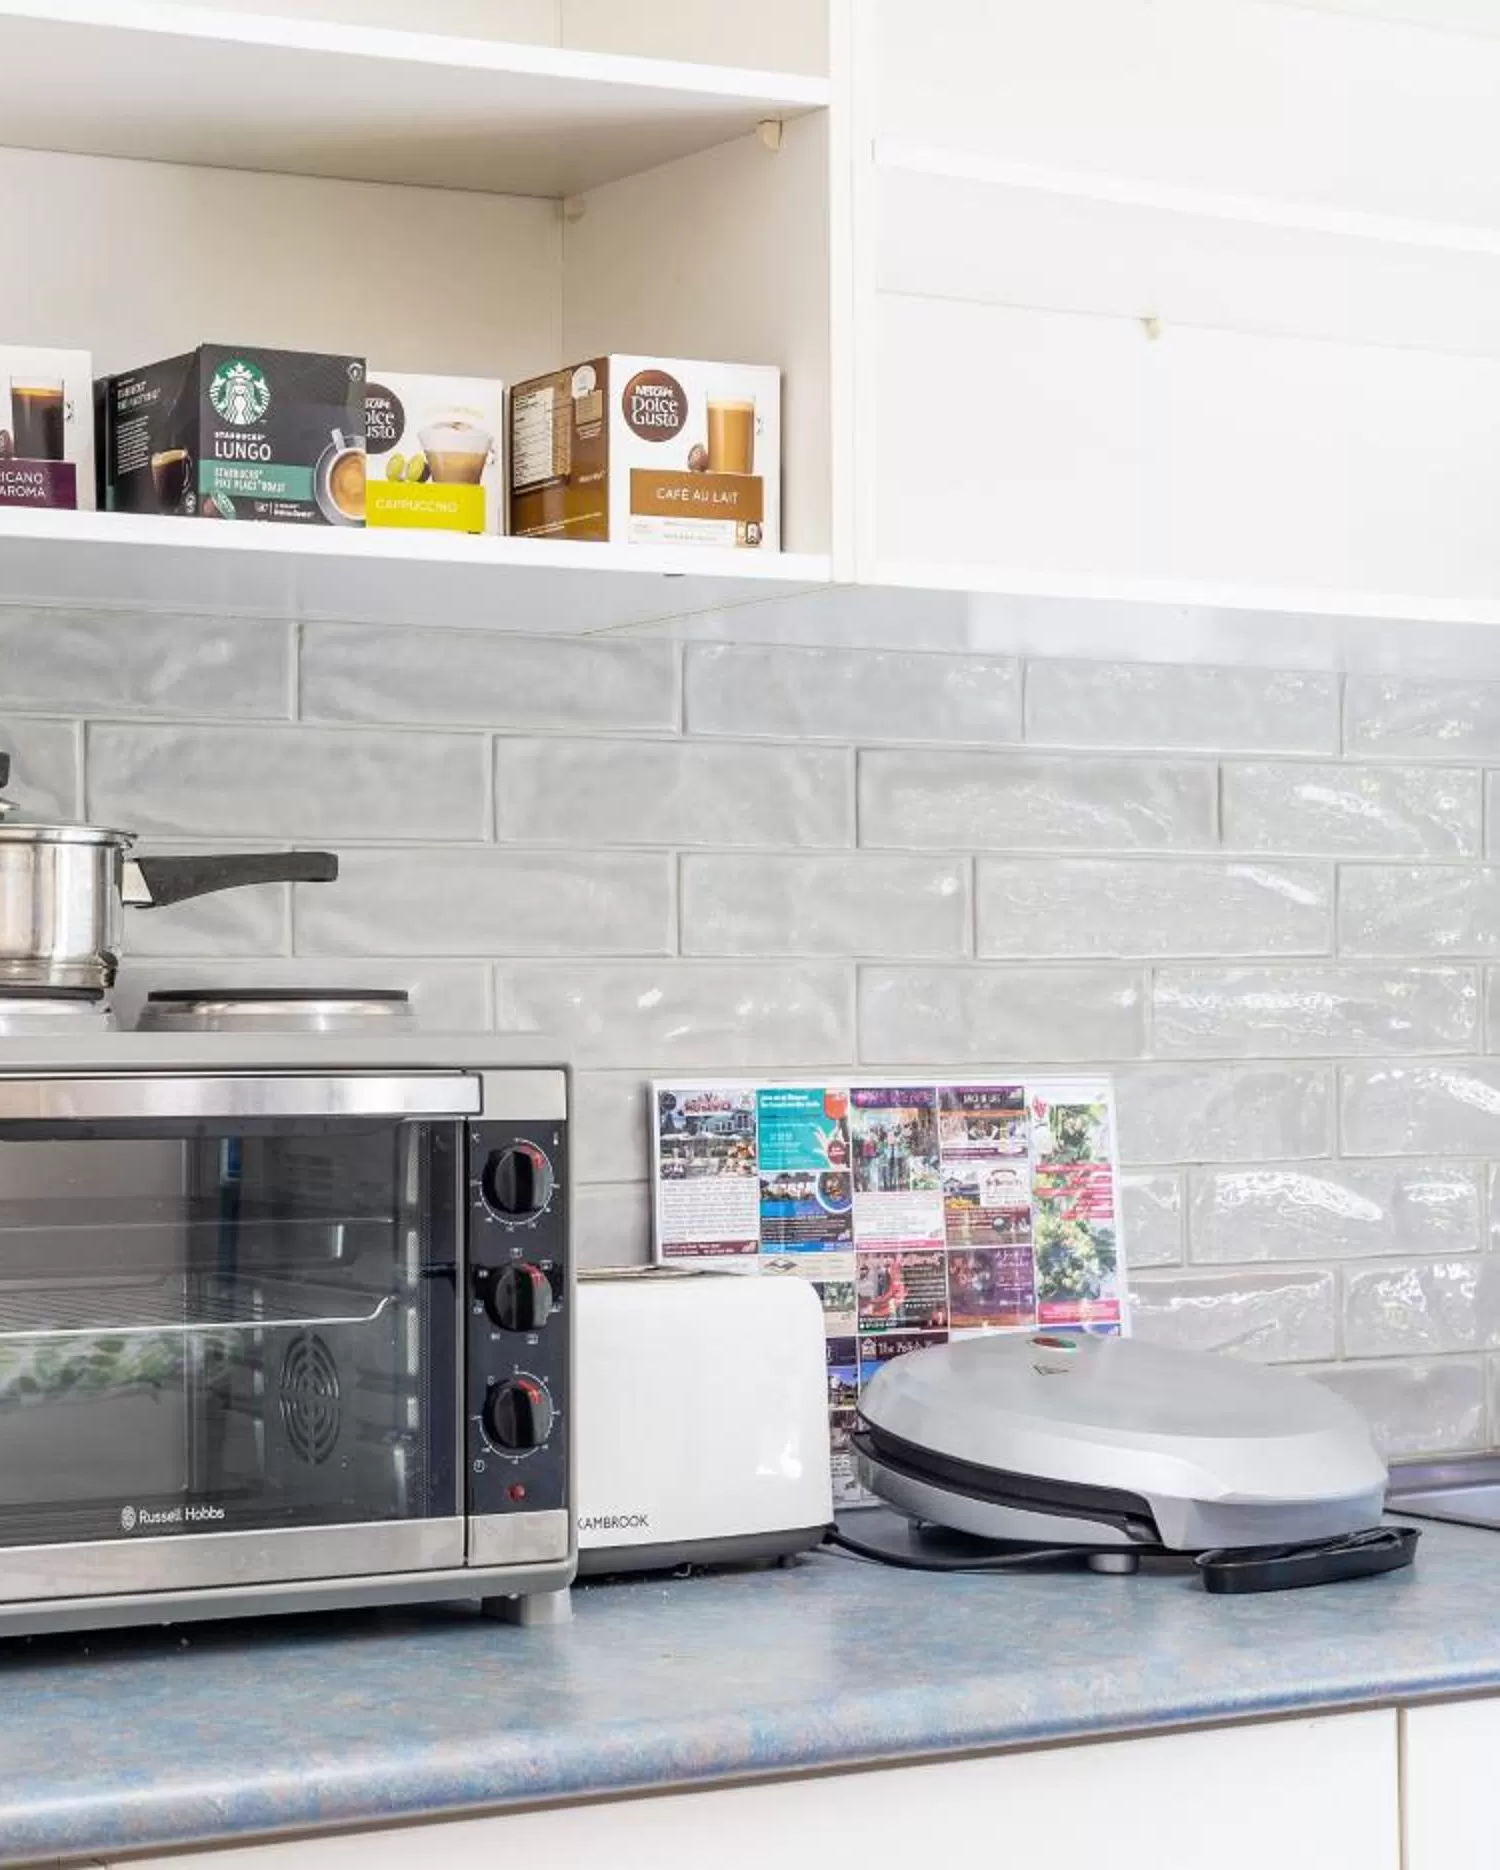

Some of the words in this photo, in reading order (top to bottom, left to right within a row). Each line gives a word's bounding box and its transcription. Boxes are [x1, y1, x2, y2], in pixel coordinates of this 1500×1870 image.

[630, 395, 679, 414] Dolce
[631, 410, 680, 427] Gusto
[214, 440, 272, 461] LUNGO
[374, 496, 459, 514] CAPPUCCINO
[656, 487, 690, 501] CAFÉ
[692, 489, 710, 502] AU
[713, 491, 739, 505] LAIT
[139, 1508, 182, 1524] Russell
[184, 1505, 226, 1520] Hobbs
